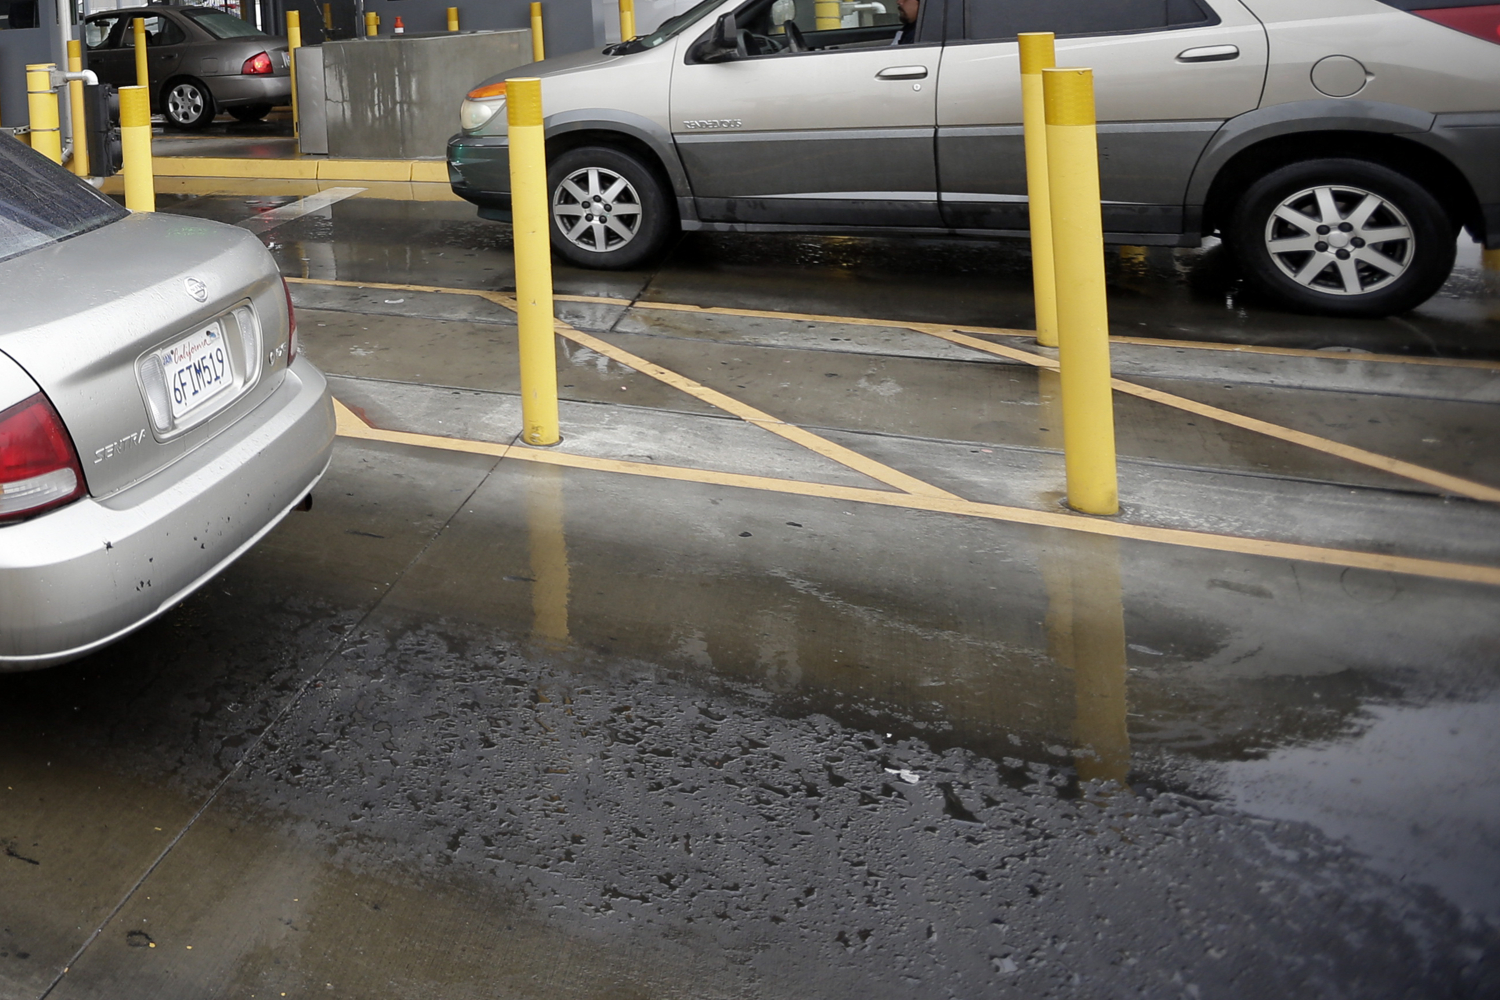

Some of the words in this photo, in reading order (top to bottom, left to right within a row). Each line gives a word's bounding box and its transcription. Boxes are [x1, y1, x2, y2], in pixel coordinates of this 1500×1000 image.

[173, 339, 211, 364] California
[173, 347, 224, 404] 6FIM519
[94, 429, 146, 463] SENTRA
